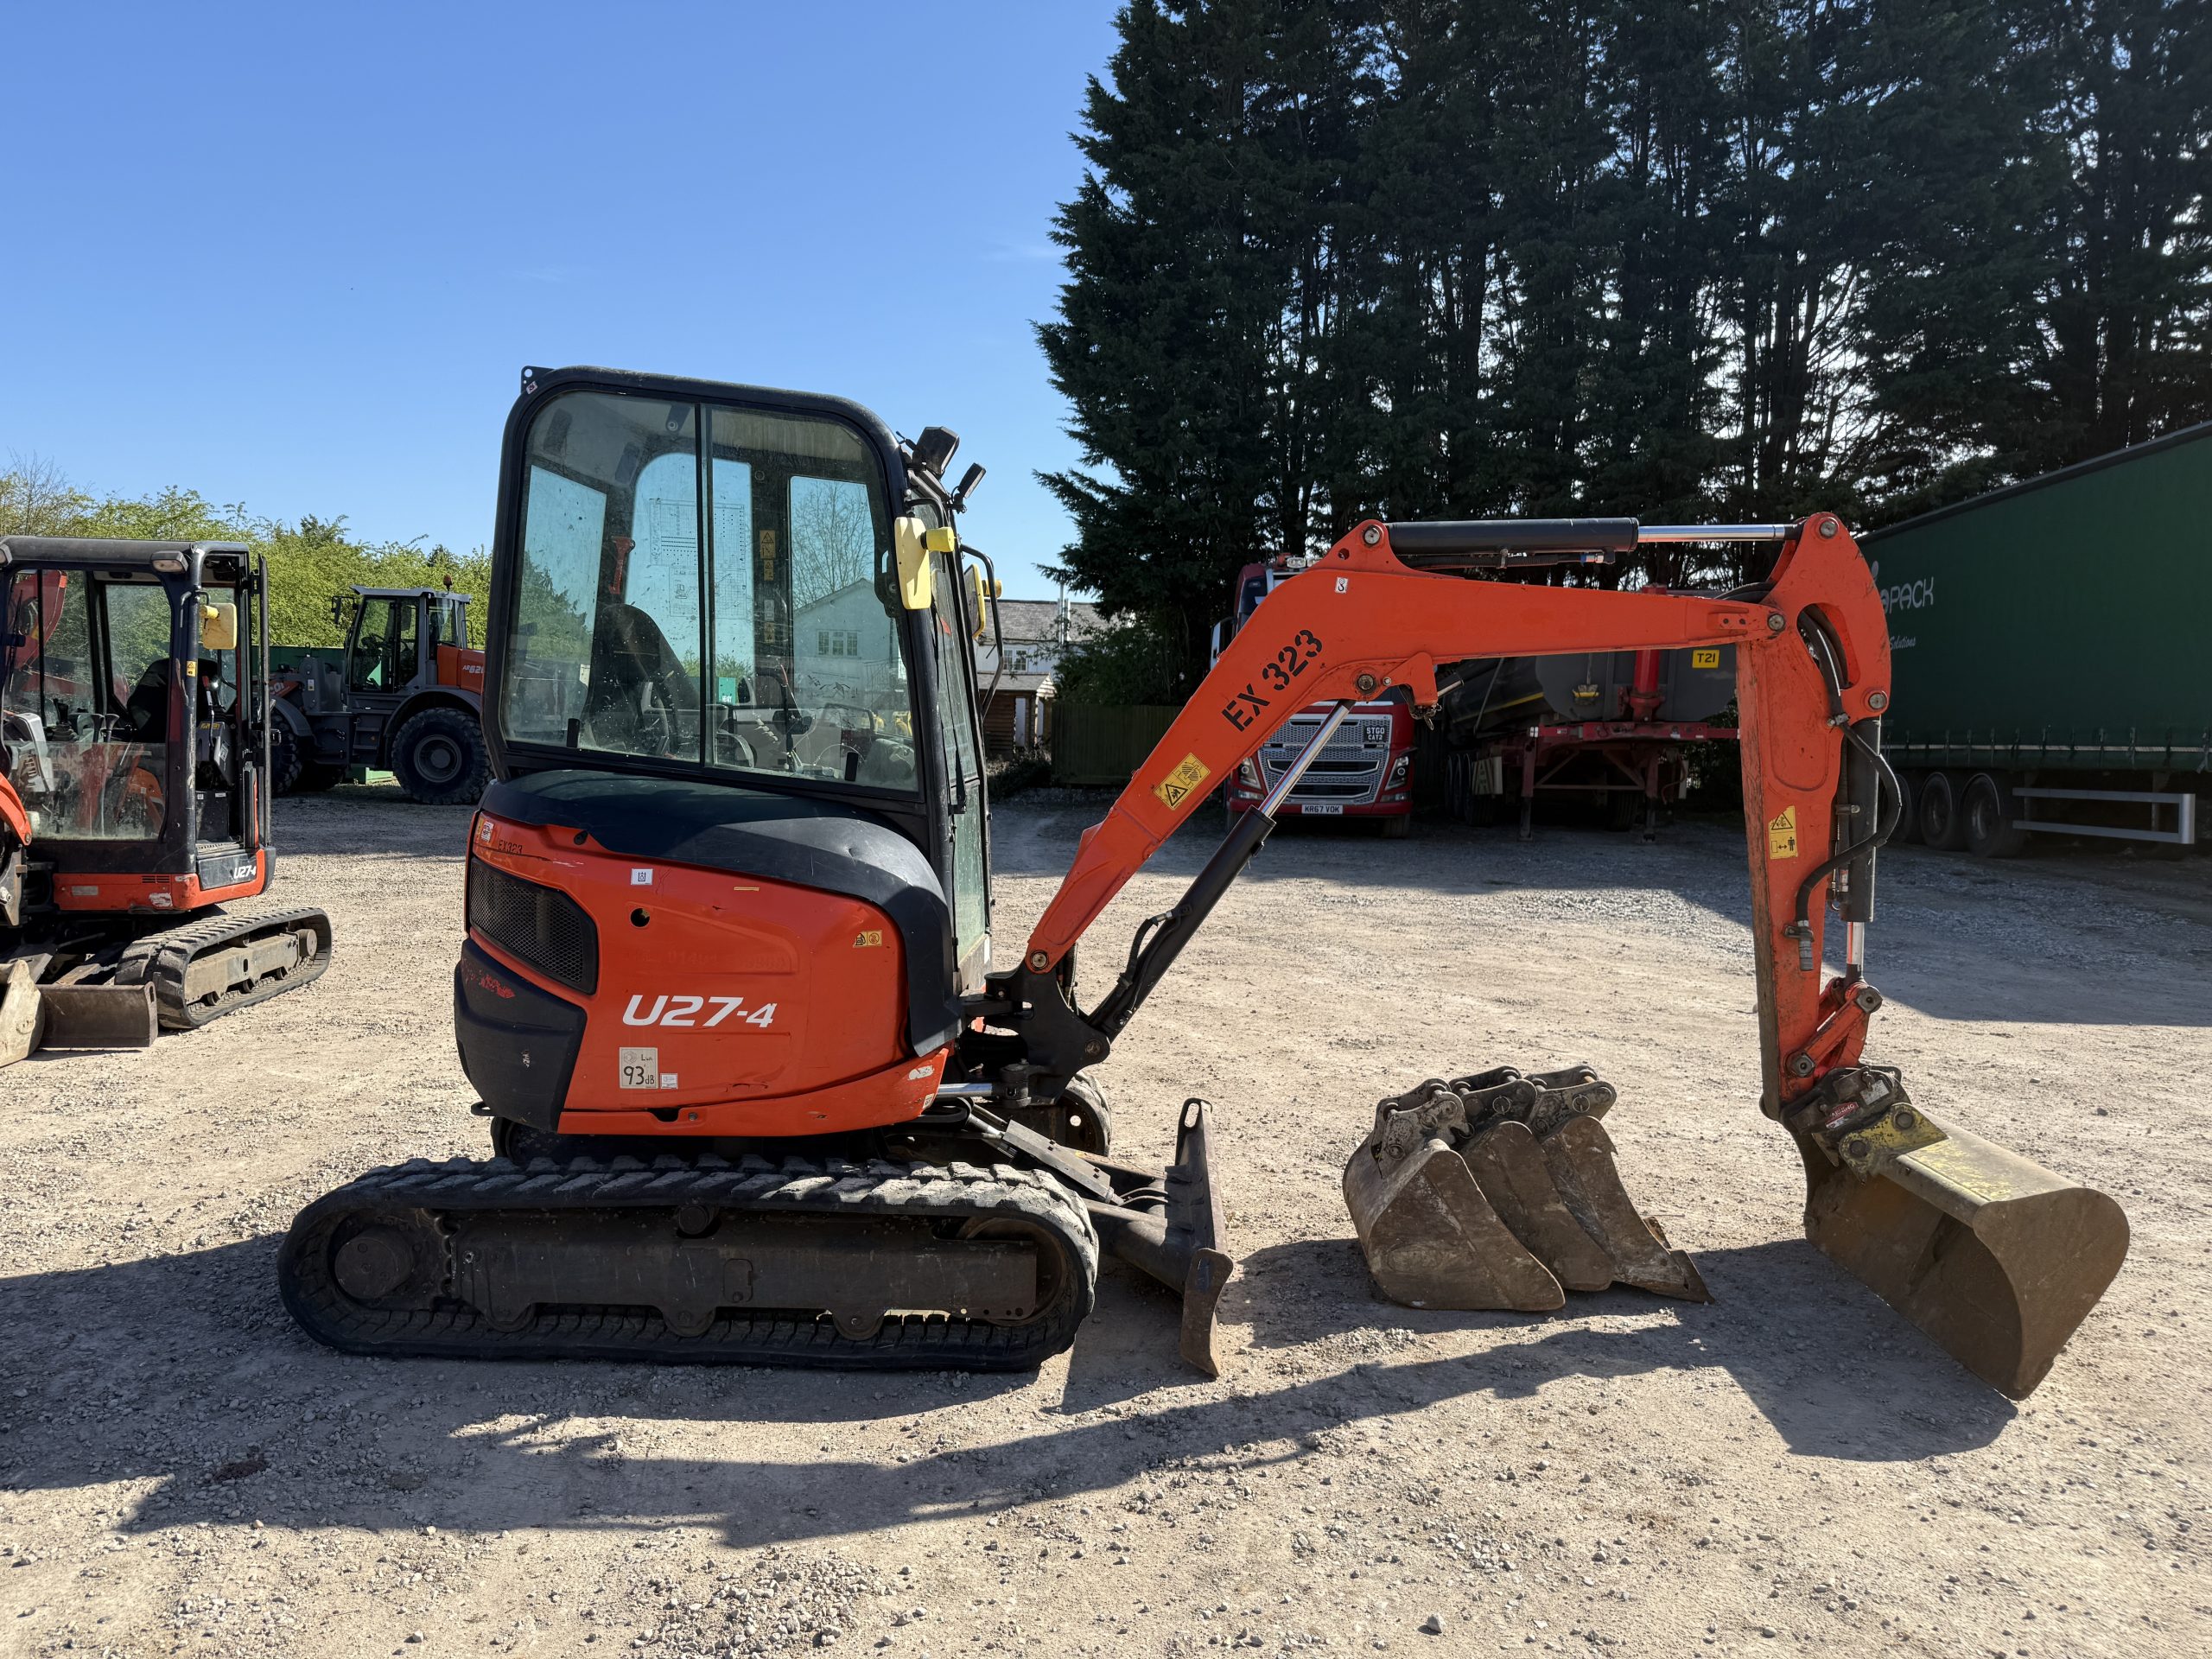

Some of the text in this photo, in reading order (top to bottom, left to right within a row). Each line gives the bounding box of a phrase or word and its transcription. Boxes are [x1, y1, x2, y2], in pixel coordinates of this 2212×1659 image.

[1890, 635, 1916, 650] Solutions
[1697, 652, 1716, 664] T21
[1221, 629, 1323, 732] EX 323
[499, 840, 523, 854] EX323
[233, 865, 257, 879] U27-4
[622, 995, 778, 1028] U27-4
[623, 1065, 645, 1085] 93
[645, 1074, 655, 1084] dB
